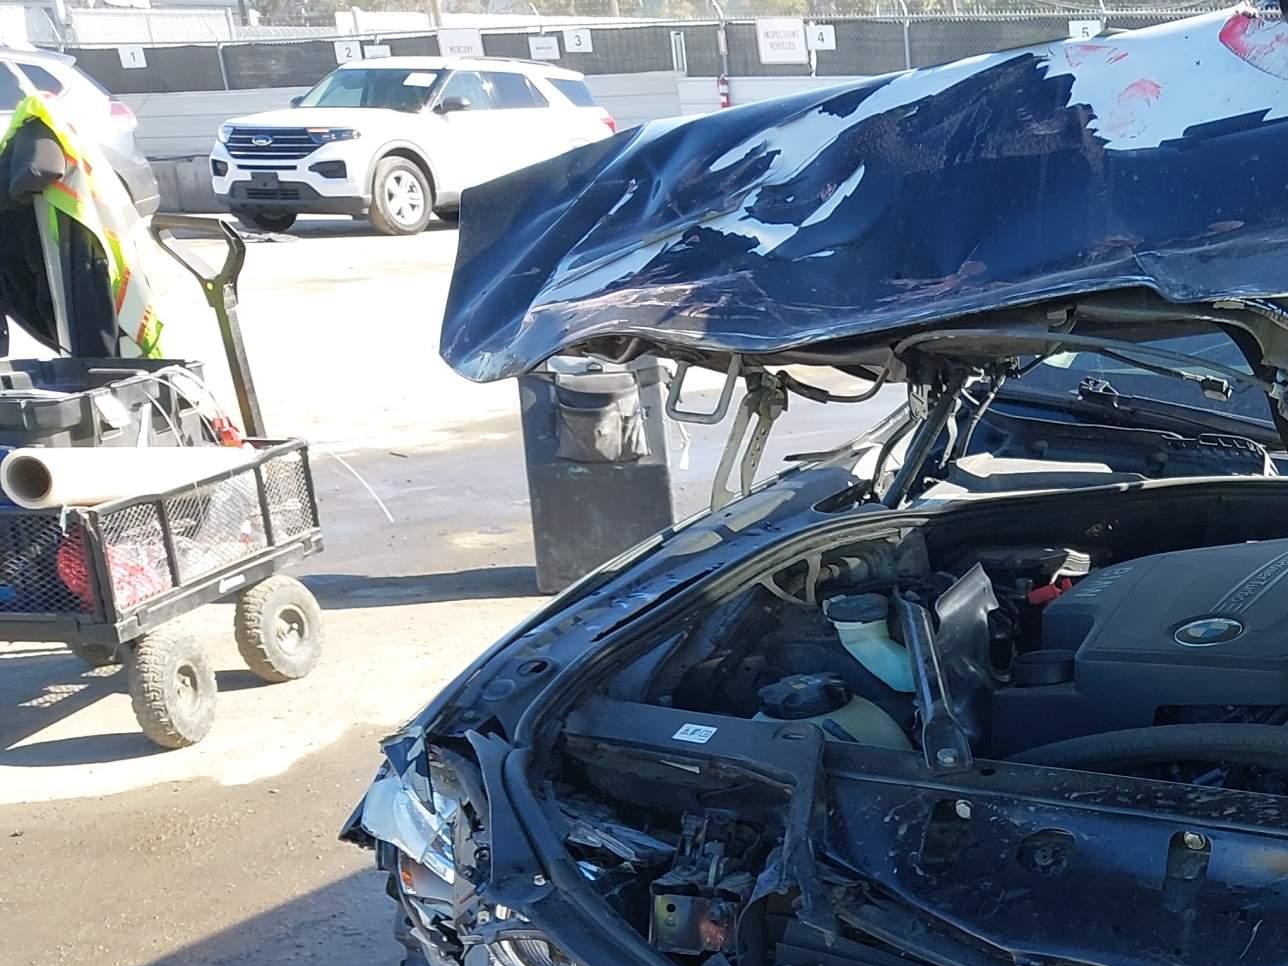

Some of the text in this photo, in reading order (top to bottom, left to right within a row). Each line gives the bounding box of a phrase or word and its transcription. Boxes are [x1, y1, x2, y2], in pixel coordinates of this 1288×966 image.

[817, 32, 825, 44] 4
[1081, 26, 1089, 38] 5
[574, 35, 582, 47] 3
[129, 51, 136, 63] 1
[345, 47, 353, 58] 2
